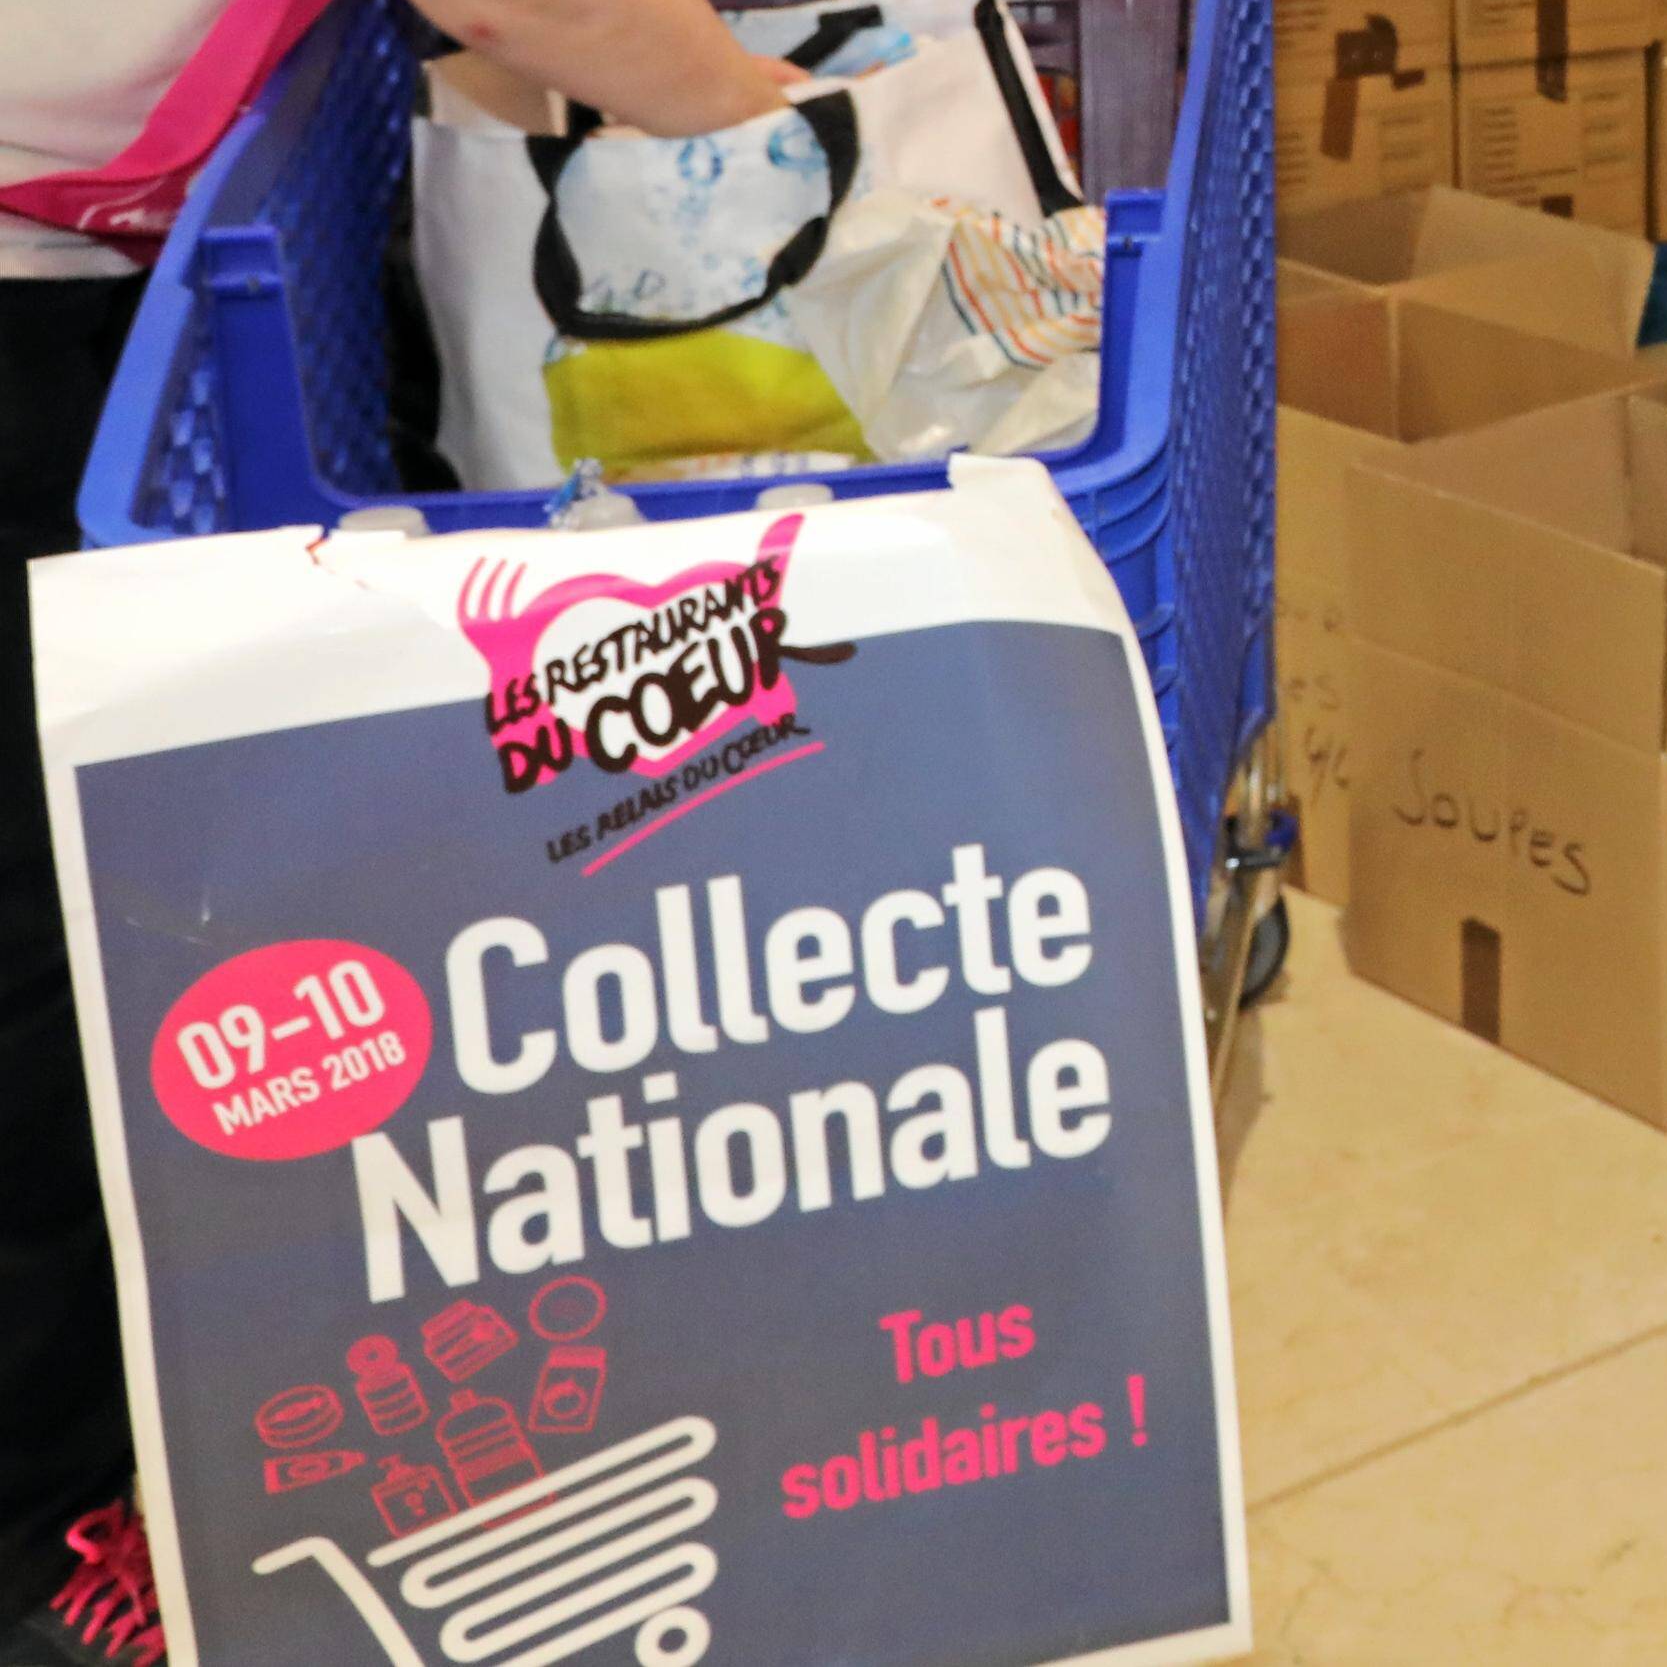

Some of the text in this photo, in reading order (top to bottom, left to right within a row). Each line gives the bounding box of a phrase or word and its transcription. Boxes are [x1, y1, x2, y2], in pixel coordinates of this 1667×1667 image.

[484, 554, 784, 736] LES RESTAURANTS
[497, 717, 573, 795] DU
[545, 828, 592, 864] LES
[594, 775, 680, 840] RELAIS
[681, 756, 721, 794] DU
[444, 842, 1096, 1097] Collecte
[213, 1030, 409, 1138] MARS 2018
[351, 1005, 1115, 1305] Nationale
[878, 1299, 1037, 1389] Tous
[779, 1395, 1107, 1522] solidaires
